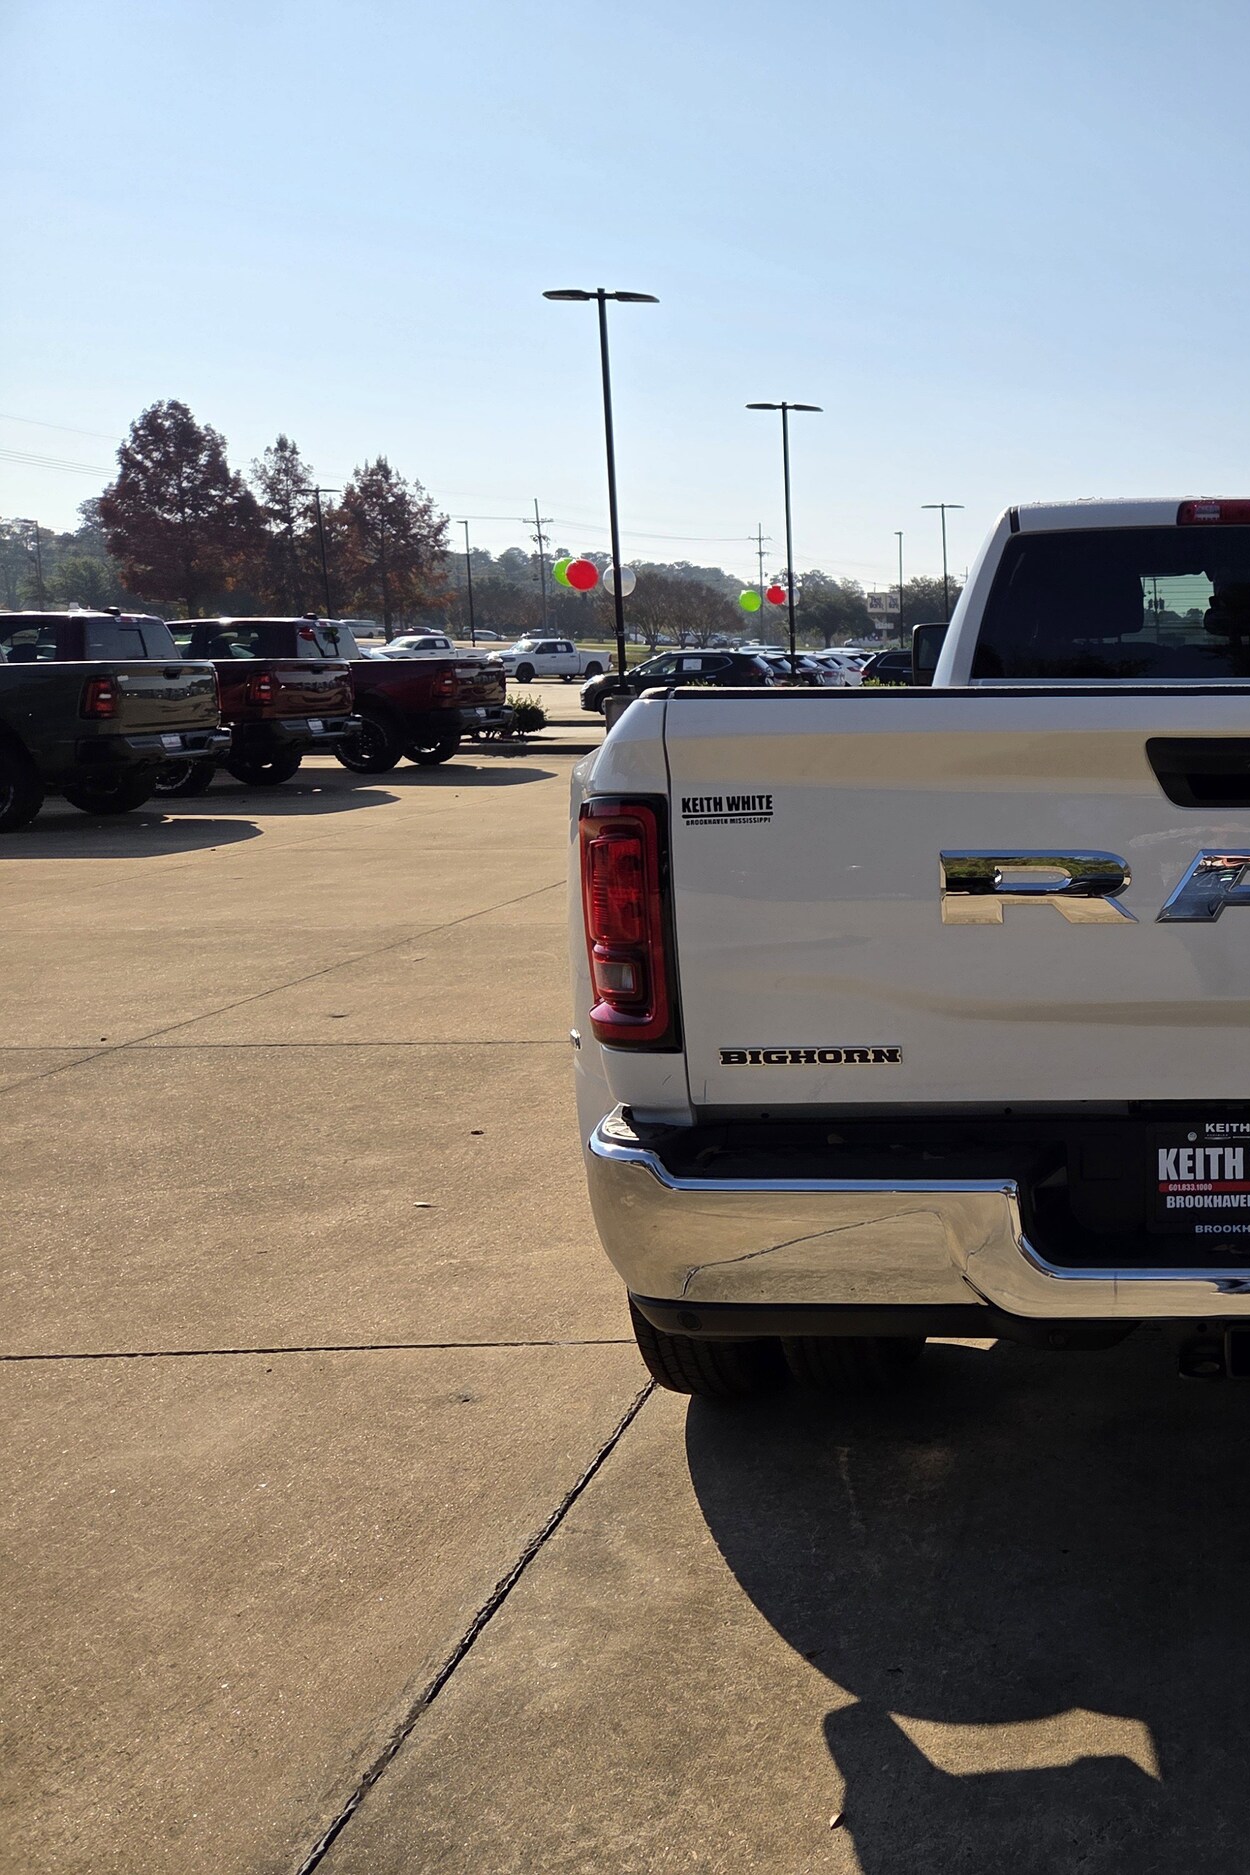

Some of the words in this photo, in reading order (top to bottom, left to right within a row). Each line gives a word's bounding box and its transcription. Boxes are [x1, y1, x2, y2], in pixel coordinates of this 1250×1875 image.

[682, 797, 723, 813] KEITH
[726, 795, 773, 811] WHITE
[719, 1047, 902, 1066] BIGHORN
[1205, 1123, 1250, 1133] KEITH
[1158, 1148, 1244, 1180] KEITH
[1168, 1183, 1213, 1192] 601.833.1000
